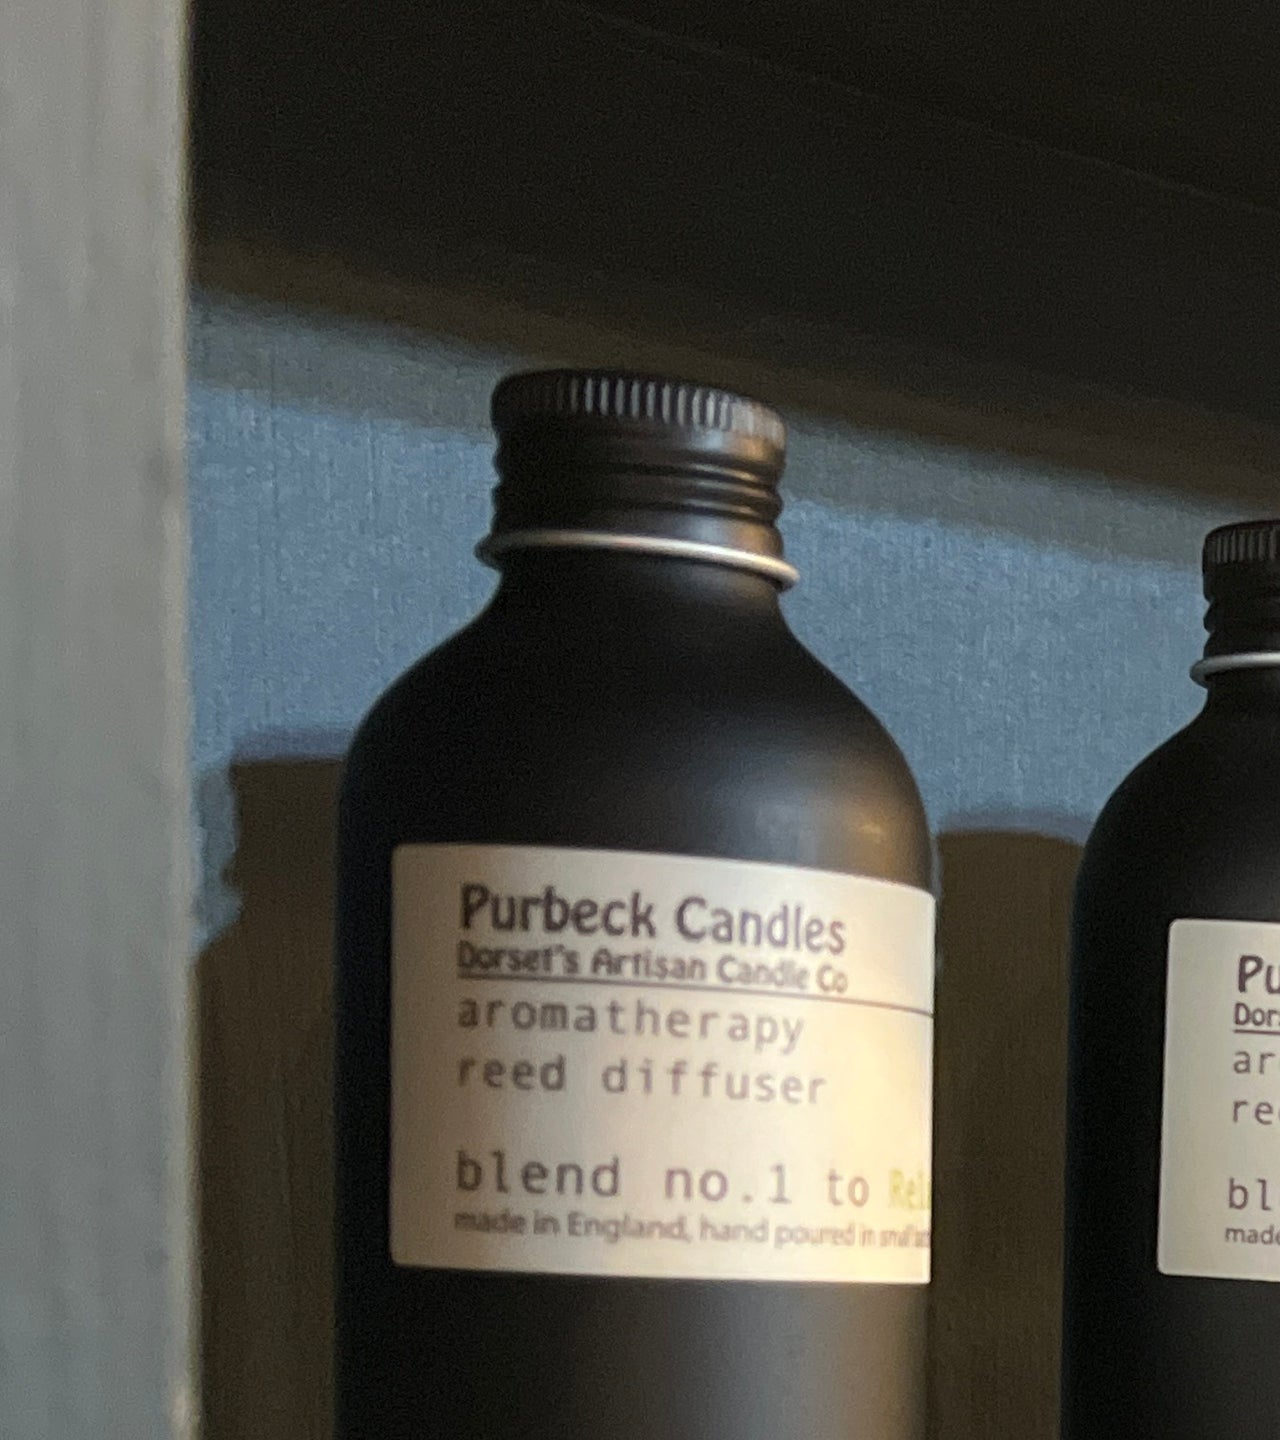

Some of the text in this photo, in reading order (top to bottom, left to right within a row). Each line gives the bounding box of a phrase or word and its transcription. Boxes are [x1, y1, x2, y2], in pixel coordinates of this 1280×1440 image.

[459, 882, 846, 955] Purbeck Candles
[457, 940, 849, 995] Dorset's Artisan Candle Co
[457, 997, 805, 1053] aromatherapy
[457, 1053, 828, 1106] reed diffuser
[456, 1149, 621, 1199] blend
[664, 1163, 793, 1205] no.1
[826, 1168, 869, 1208] to
[454, 1209, 525, 1236] made
[533, 1212, 560, 1236] in
[567, 1213, 691, 1244] England,
[699, 1218, 769, 1244] hand
[775, 1221, 855, 1249] poured
